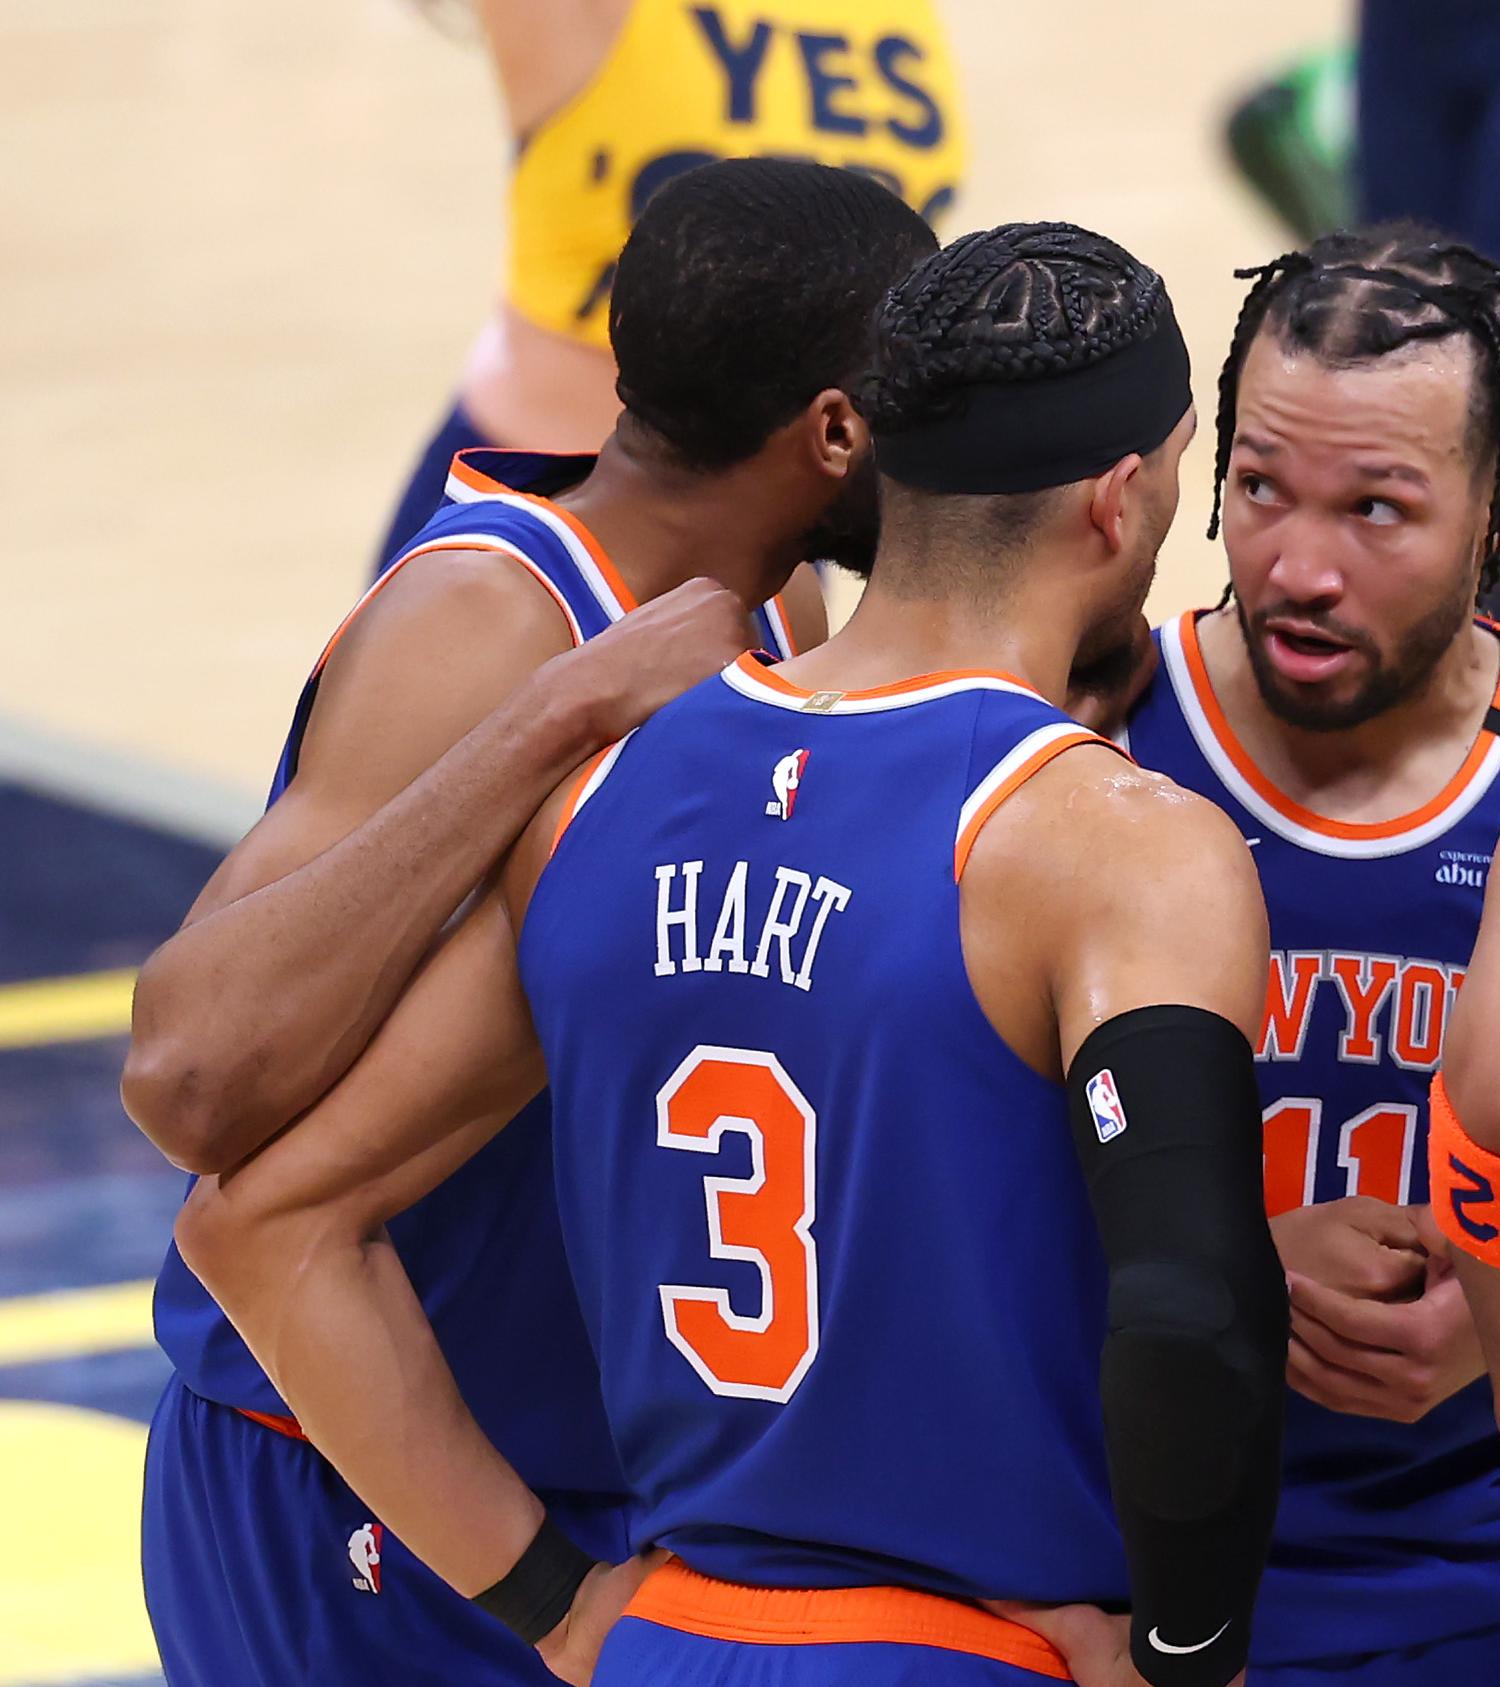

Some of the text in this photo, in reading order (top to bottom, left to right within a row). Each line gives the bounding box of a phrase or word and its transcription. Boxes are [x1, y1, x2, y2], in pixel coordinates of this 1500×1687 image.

[691, 4, 944, 148] YES
[1435, 862, 1483, 888] abu
[1439, 850, 1492, 864] experien
[654, 860, 853, 991] HART
[1328, 949, 1467, 1073] YO
[1261, 1097, 1419, 1219] 11
[656, 1044, 819, 1404] 3
